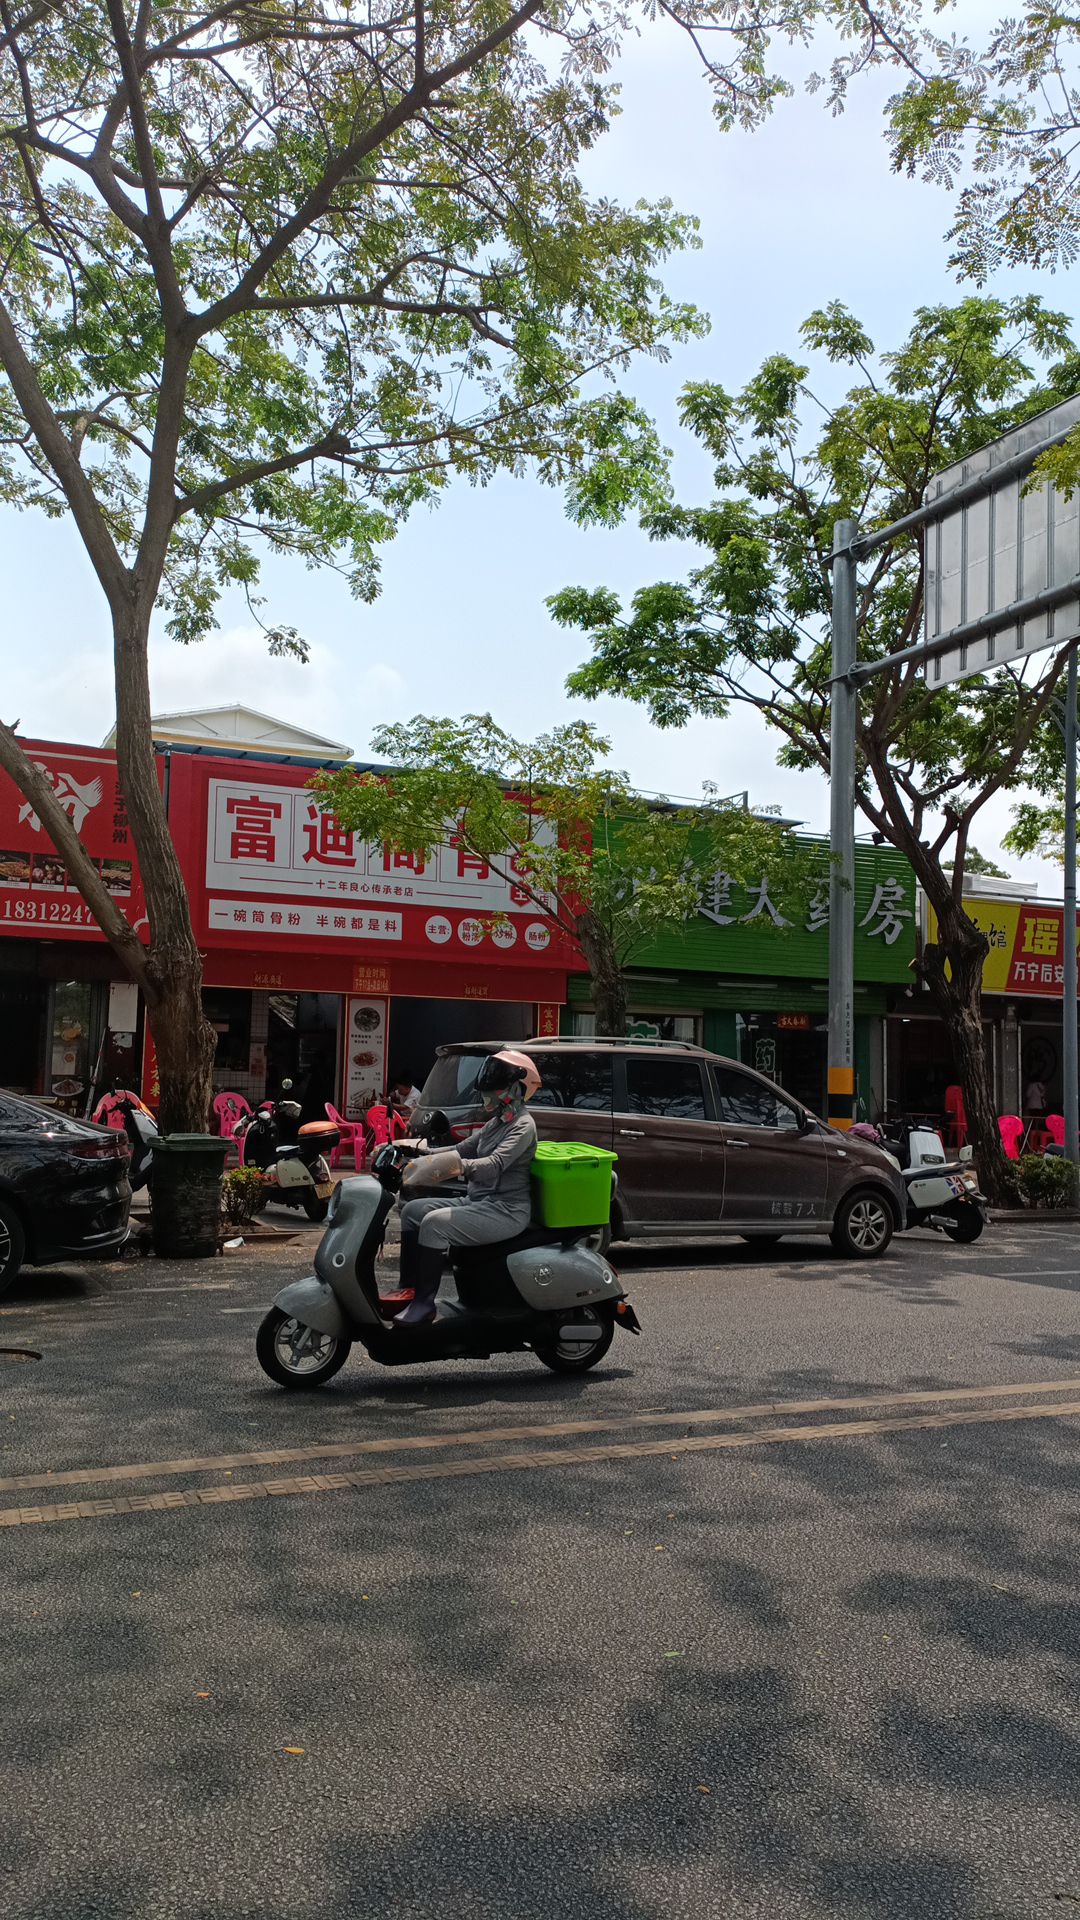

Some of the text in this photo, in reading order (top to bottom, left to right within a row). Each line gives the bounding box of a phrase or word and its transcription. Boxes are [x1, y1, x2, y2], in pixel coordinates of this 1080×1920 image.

[315, 879, 415, 898] 十二年良心传承老店
[3, 899, 127, 924] 18312247
[214, 908, 397, 933] 一碗筒骨粉 半碗都是料
[1021, 917, 1060, 956] 瑶
